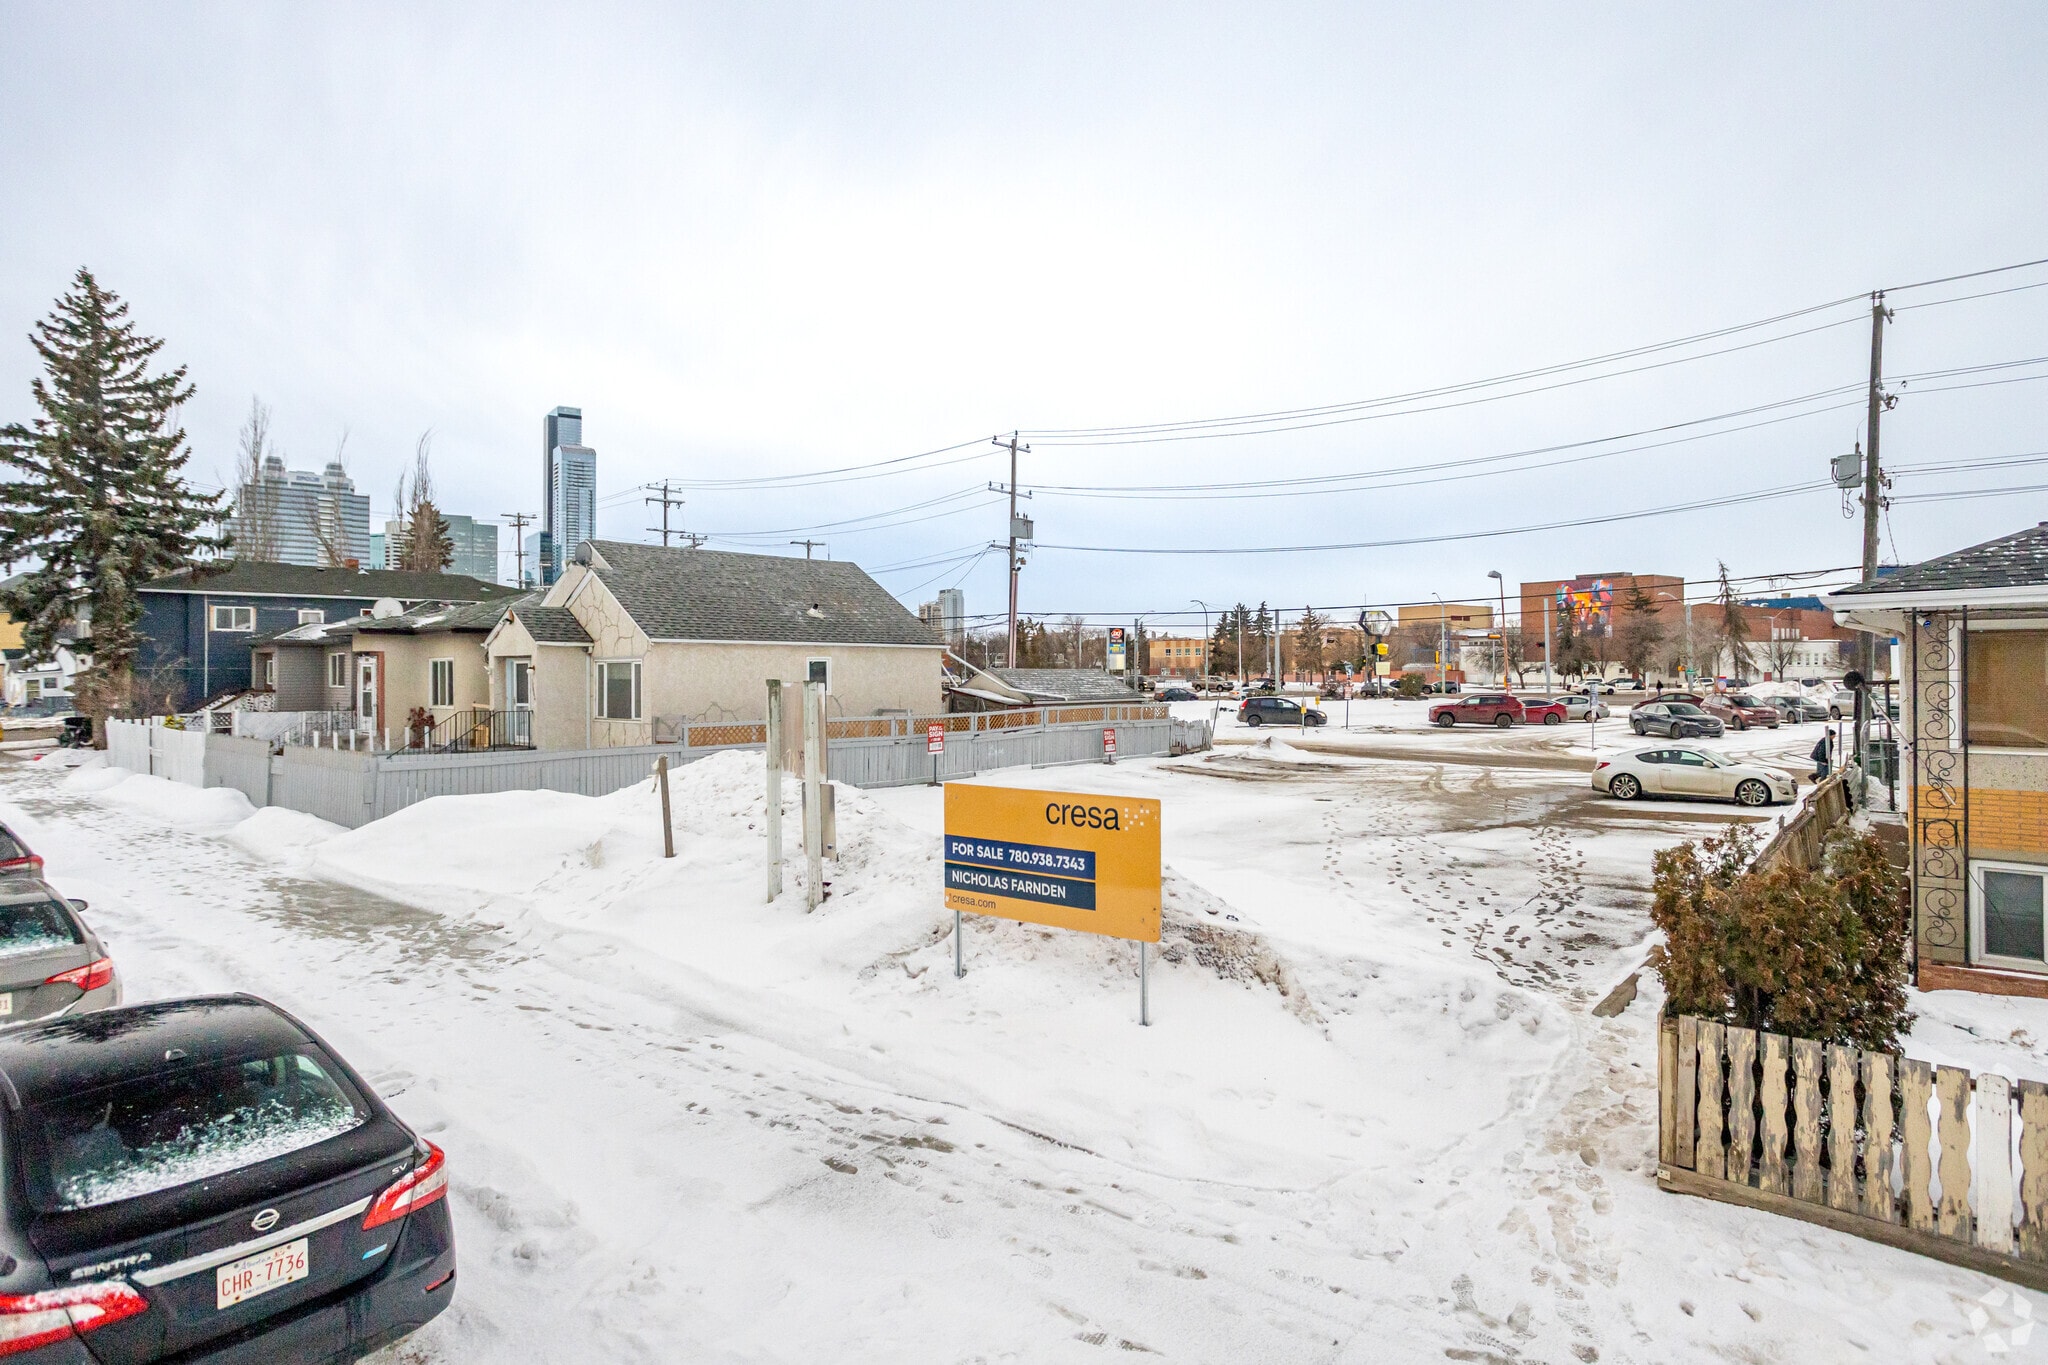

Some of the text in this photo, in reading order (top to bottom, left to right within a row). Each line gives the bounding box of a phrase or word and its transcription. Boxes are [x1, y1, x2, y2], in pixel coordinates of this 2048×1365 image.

[1046, 803, 1120, 830] cresa
[952, 842, 1086, 871] FOR SALE 780.938.7343
[952, 870, 1066, 899] NICHOLAS FARNDEN
[952, 895, 997, 909] cresa.com
[391, 1162, 408, 1176] SV
[221, 1251, 305, 1297] CHR-7736
